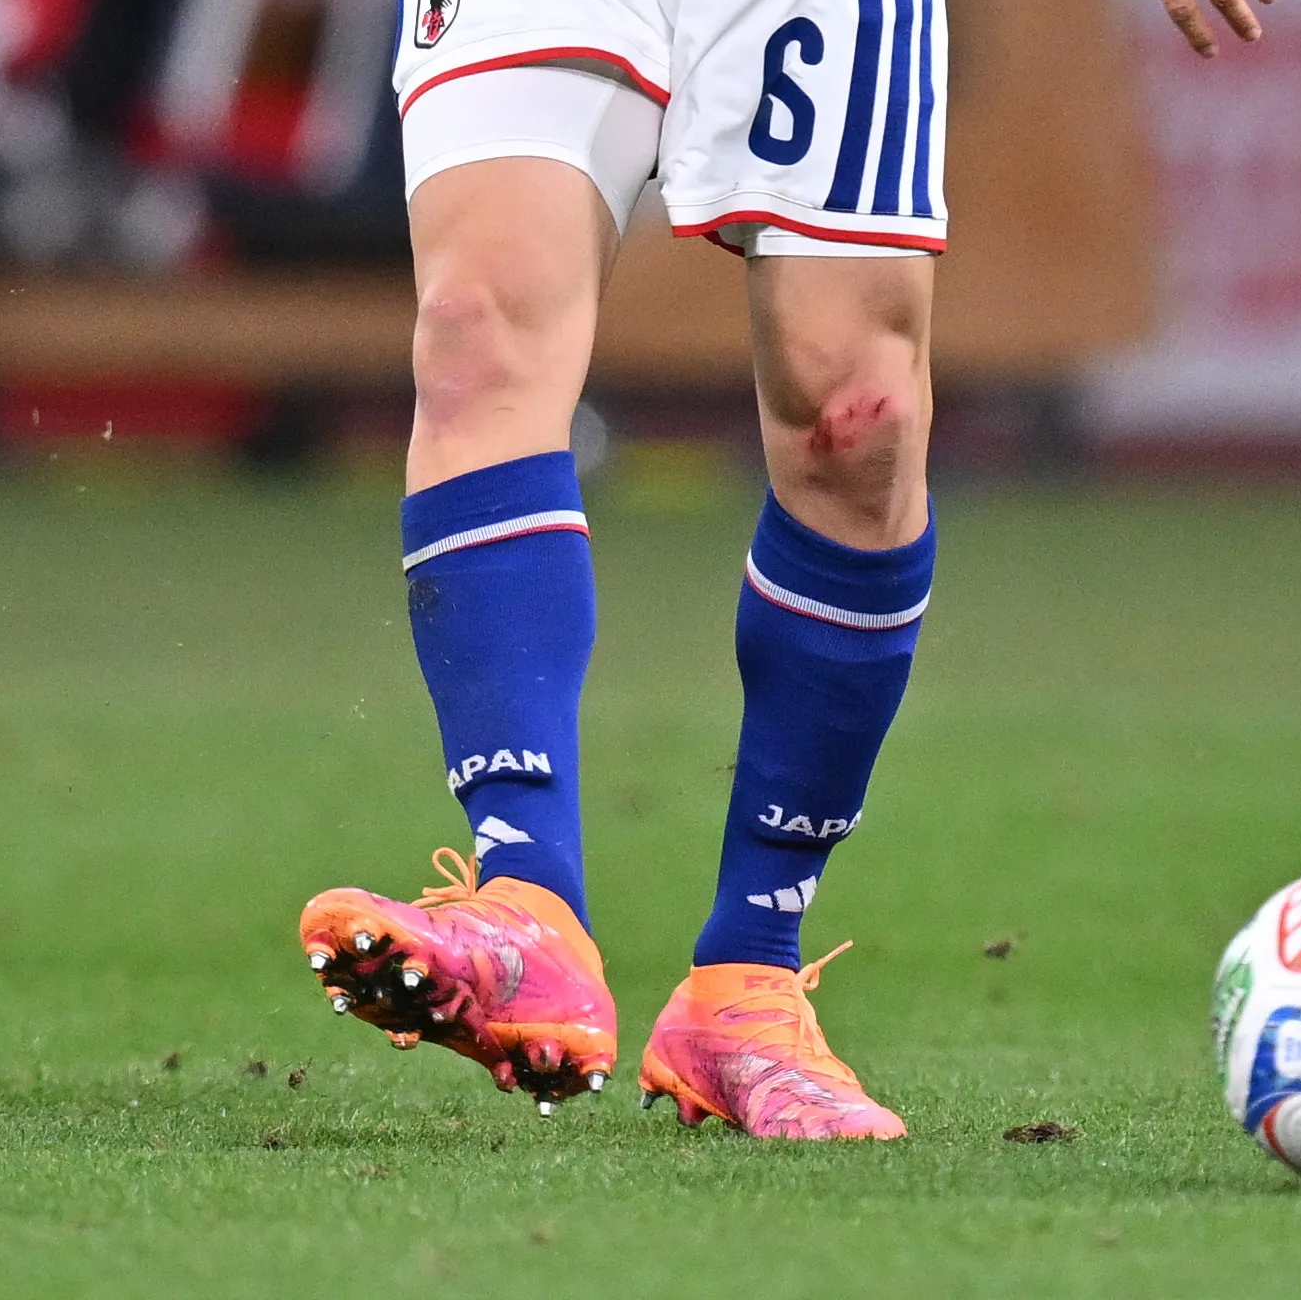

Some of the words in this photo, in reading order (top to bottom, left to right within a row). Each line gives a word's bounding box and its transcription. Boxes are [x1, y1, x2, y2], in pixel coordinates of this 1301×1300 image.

[748, 16, 824, 166] 6
[447, 748, 552, 796] APAN
[758, 804, 862, 838] JAP
